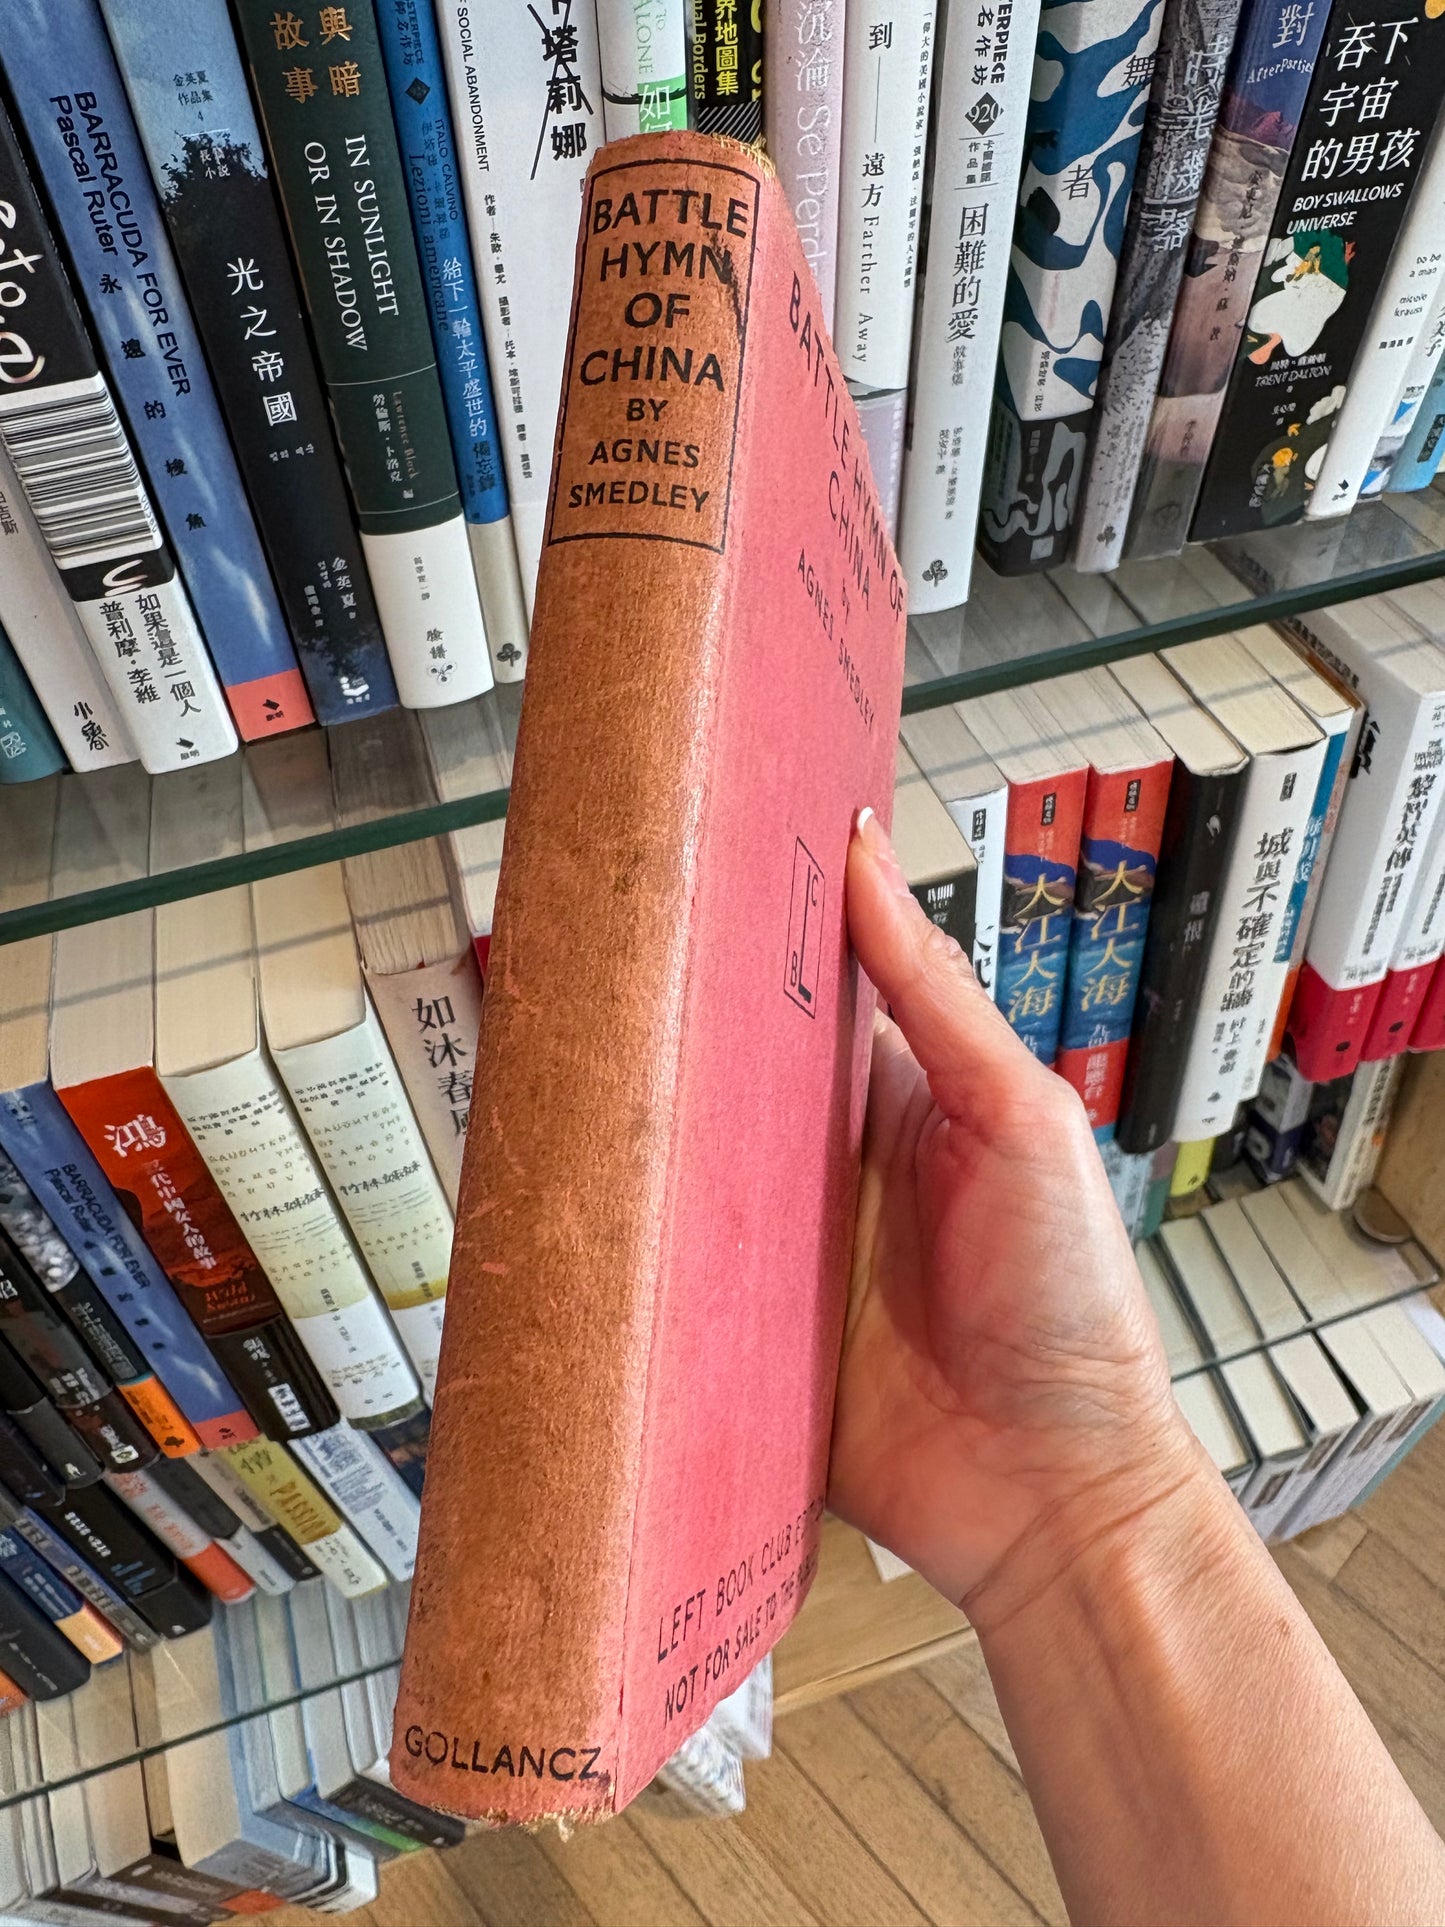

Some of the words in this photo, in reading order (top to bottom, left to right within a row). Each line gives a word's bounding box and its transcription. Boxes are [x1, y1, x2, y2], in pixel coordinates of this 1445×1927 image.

[271, 12, 319, 103] 故事
[320, 7, 361, 97] 與暗
[457, 7, 474, 63] SOCIAL
[869, 22, 893, 50] 到
[971, 5, 995, 86] 名作坊
[991, 0, 1012, 84] ERPIECE
[1334, 17, 1419, 71] 吞下
[173, 69, 208, 87] 金英夏
[541, 0, 588, 161] 塔莉娜
[692, 34, 708, 100] Borders
[178, 89, 214, 106] 作品集
[465, 65, 490, 172] ABANDONMENT
[968, 103, 1001, 125] 920
[1319, 76, 1399, 127] 宇宙
[49, 95, 96, 183] Pascal
[83, 189, 119, 256] Ruter
[304, 142, 330, 184] OR
[345, 135, 370, 168] IN
[435, 119, 448, 158] ITALO
[442, 164, 458, 221] CALVINO
[1301, 127, 1421, 182] 的男孩
[861, 152, 885, 208] 遠方
[1061, 165, 1094, 200] 者
[1292, 196, 1326, 213] BOY
[1326, 183, 1404, 208] SWALLOWS
[315, 194, 341, 225] IN
[592, 188, 749, 238] BATTLE
[1286, 211, 1357, 235] UNIVERSE
[74, 91, 148, 268] BARRACUDA
[136, 272, 169, 328] FOR
[157, 332, 191, 397] EVER
[354, 180, 399, 317] SUNLIGHT
[599, 241, 733, 285] HYMN
[858, 216, 880, 295] Farther
[324, 237, 367, 351] SHADOW
[947, 203, 989, 343] 困難的愛
[624, 292, 691, 329] OF
[853, 313, 873, 363] Away
[226, 257, 297, 427] 光之帝國
[580, 346, 725, 392] CHINA
[626, 398, 668, 422] BY
[588, 438, 700, 469] AGNES
[789, 270, 850, 470] BATTLE
[889, 569, 904, 622] OF
[568, 481, 710, 513] SMEDLEY
[828, 470, 870, 611] CHINA
[797, 548, 835, 641] AGNES
[1008, 872, 1068, 1025] 大江大海
[1081, 860, 1147, 1011] 大江大海
[657, 1588, 706, 1664] LEFT
[716, 1555, 754, 1617] BOOK
[760, 1524, 792, 1575] CLUB
[664, 1665, 698, 1729] NOT
[704, 1639, 730, 1691] FOR
[734, 1605, 762, 1660] SALE
[405, 1725, 602, 1781] GOLLANCZ
